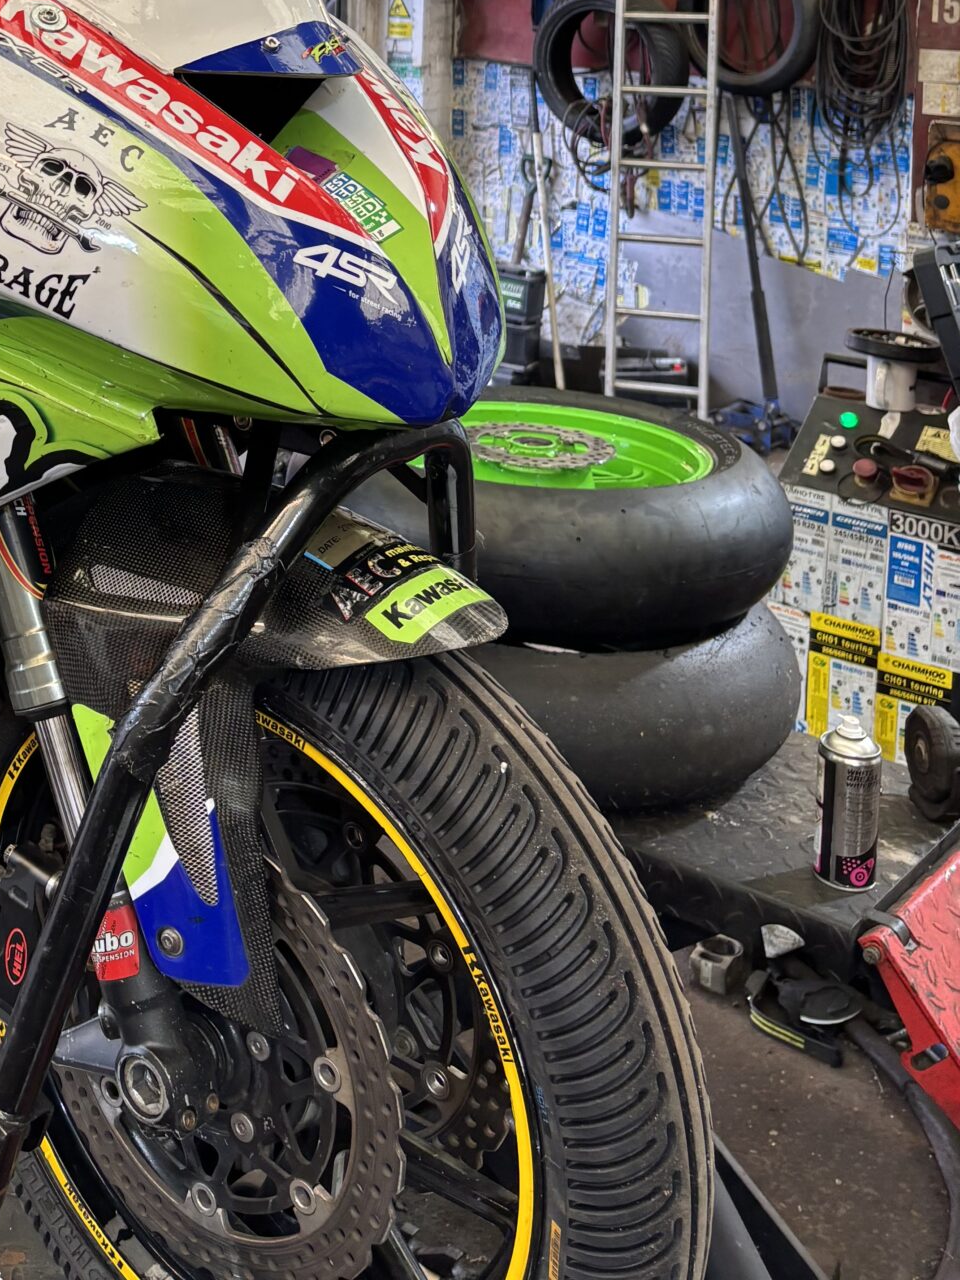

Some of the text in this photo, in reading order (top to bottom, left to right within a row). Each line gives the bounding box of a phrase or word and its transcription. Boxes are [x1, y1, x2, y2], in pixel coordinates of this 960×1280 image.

[95, 217, 112, 231] 2010
[349, 289, 402, 321] for street racing
[317, 536, 341, 554] DATE:
[922, 543, 935, 610] HIFLY
[824, 618, 876, 638] CHARMHOO
[841, 639, 873, 656] touring
[891, 659, 946, 681] CHARMHOO
[910, 682, 944, 699] touring
[12, 942, 24, 978] HEL
[474, 970, 514, 1064] Kawasaki
[64, 1181, 111, 1251] Kawasaki
